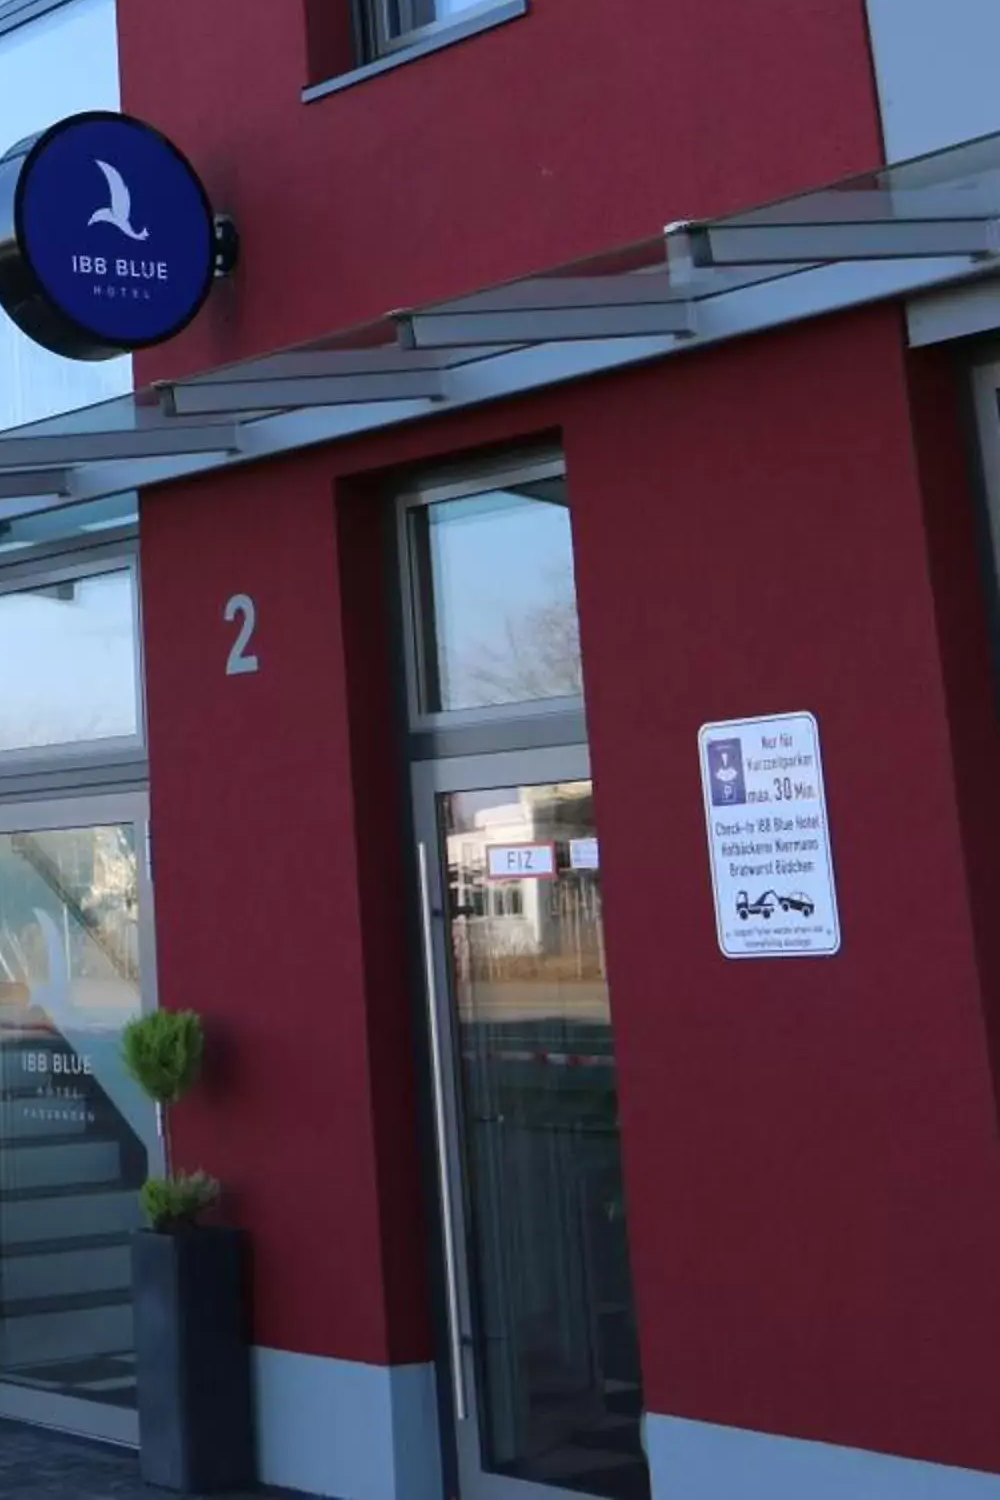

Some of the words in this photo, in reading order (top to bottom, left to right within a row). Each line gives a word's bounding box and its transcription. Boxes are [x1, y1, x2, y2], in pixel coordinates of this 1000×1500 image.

[72, 255, 107, 275] IBB
[116, 259, 168, 279] BLUE
[93, 285, 150, 300] HOTEL
[224, 593, 258, 676] 2
[761, 735, 777, 749] Nur
[779, 732, 793, 747] für
[774, 777, 792, 801] 30
[773, 817, 794, 832] Blue
[795, 813, 819, 830] Hotel
[506, 850, 533, 870] FIZ
[729, 861, 774, 877] Bratwurst
[22, 1051, 48, 1073] IBB
[53, 1052, 93, 1076] BLUE
